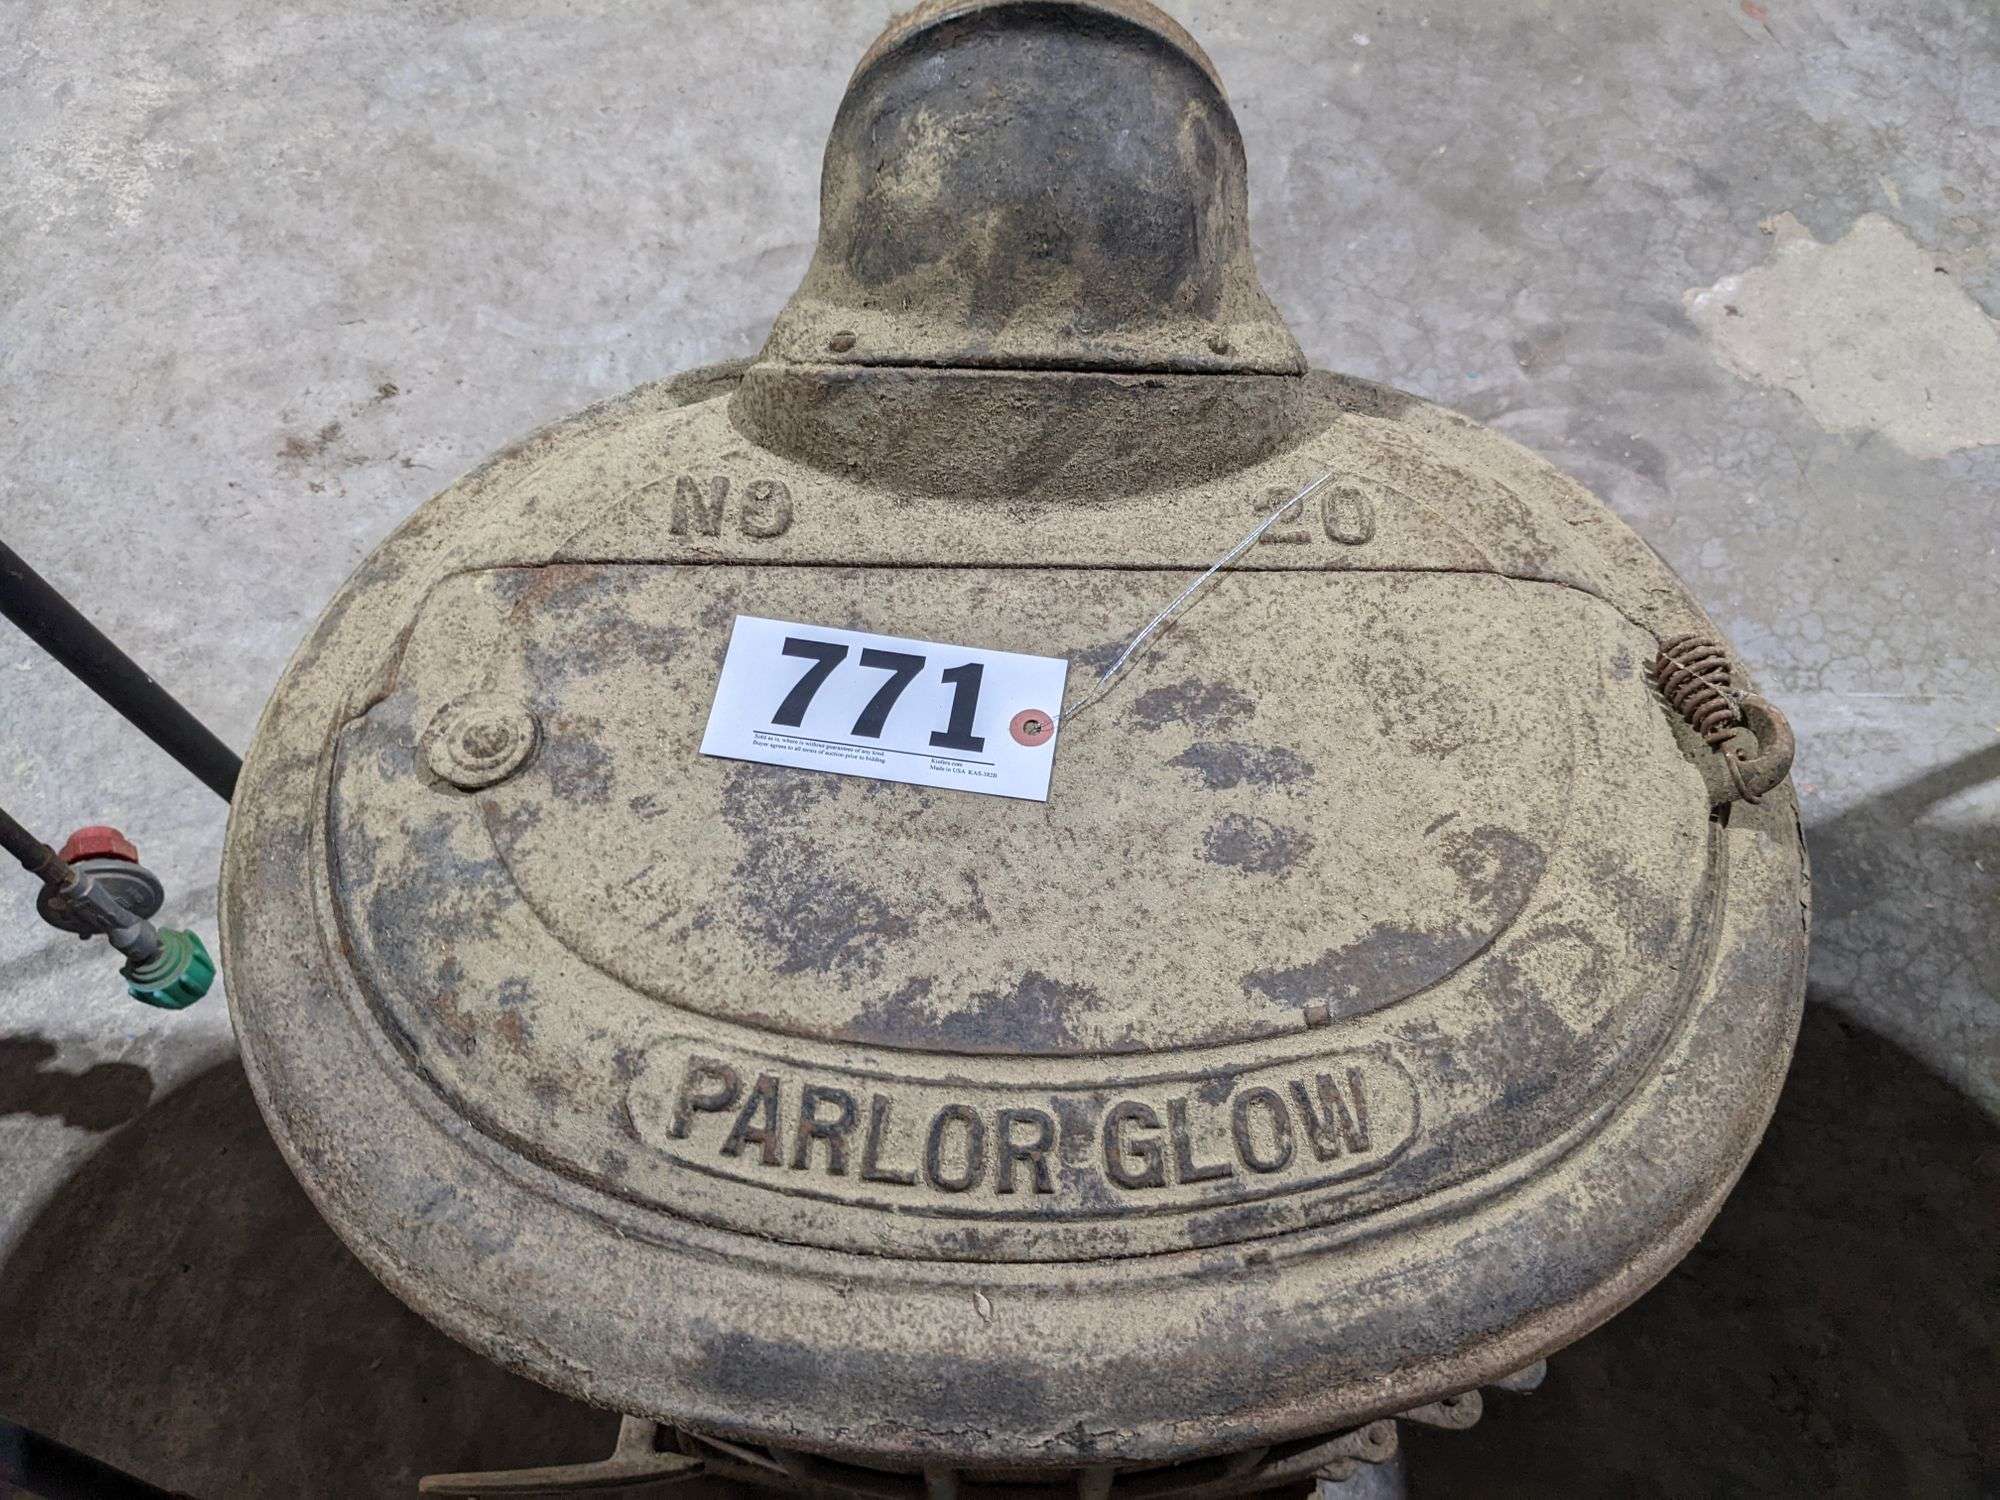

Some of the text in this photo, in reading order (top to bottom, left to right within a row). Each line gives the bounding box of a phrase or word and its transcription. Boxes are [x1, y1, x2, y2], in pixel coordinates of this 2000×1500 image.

[1255, 486, 1376, 545] 20
[772, 637, 985, 752] 771
[667, 1055, 1374, 1196] PARLOR GLOW
